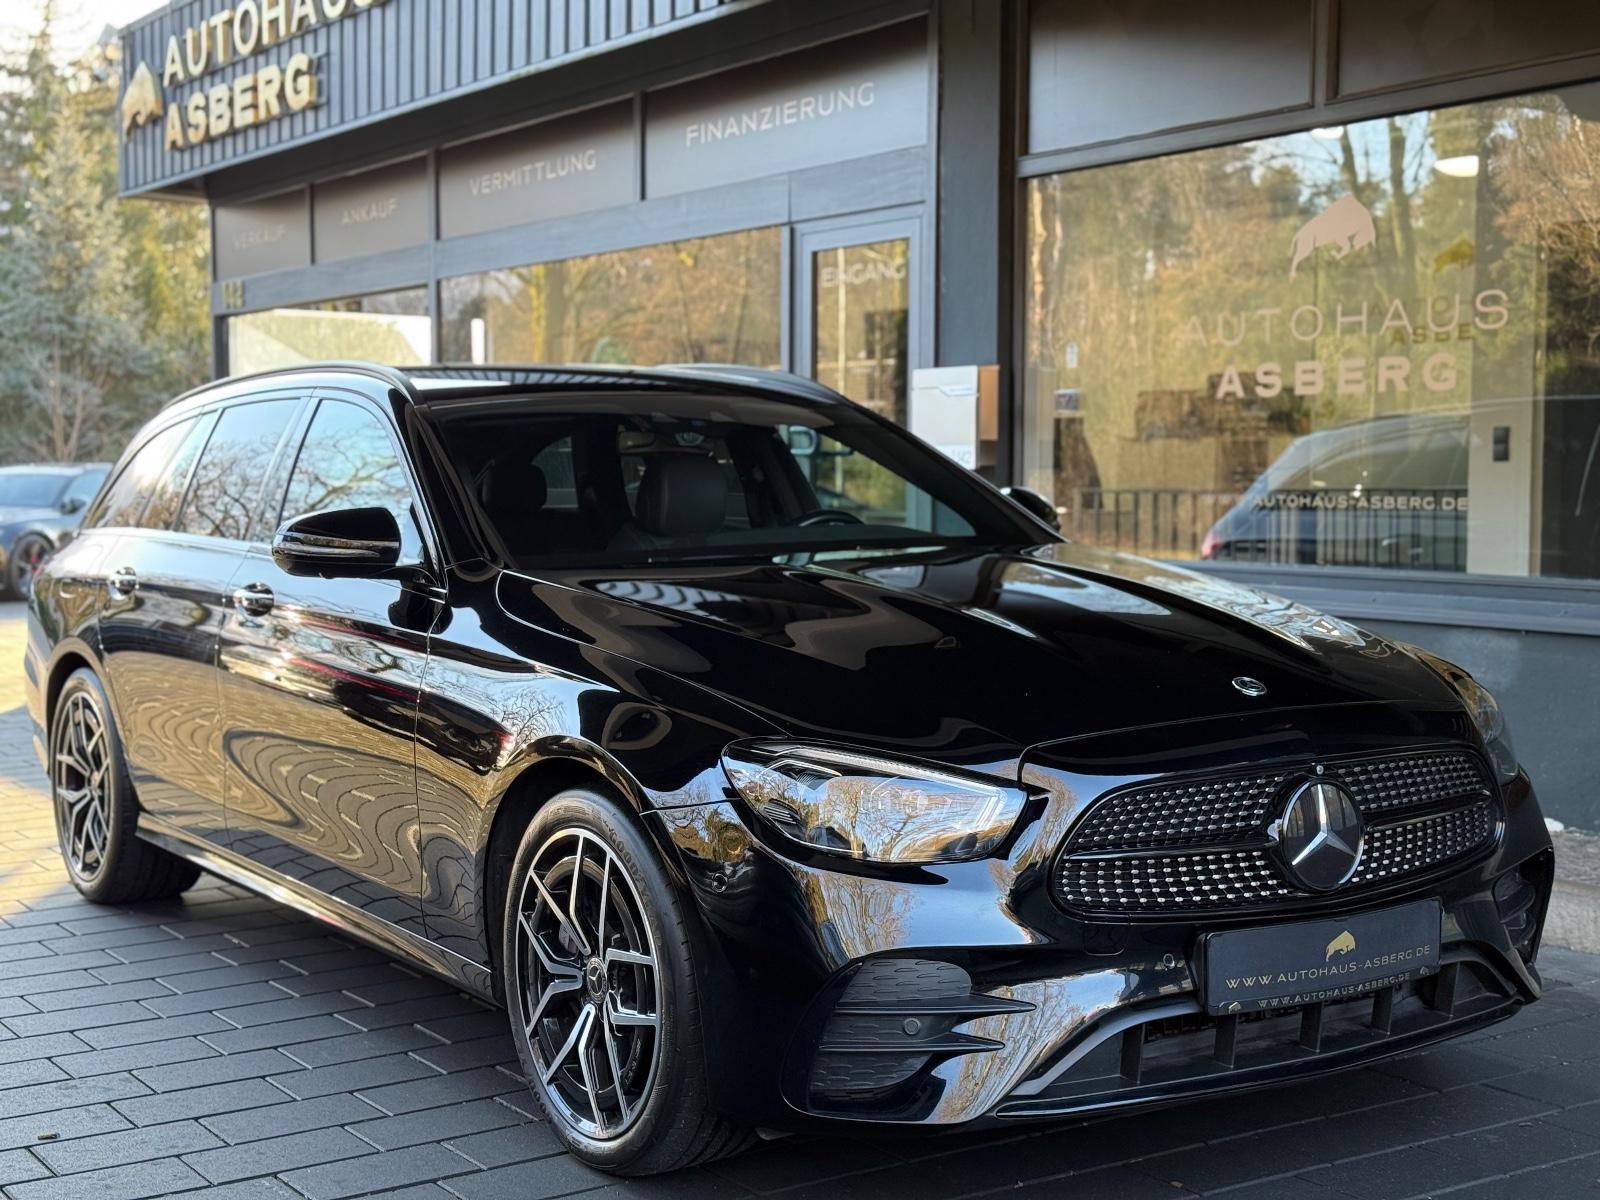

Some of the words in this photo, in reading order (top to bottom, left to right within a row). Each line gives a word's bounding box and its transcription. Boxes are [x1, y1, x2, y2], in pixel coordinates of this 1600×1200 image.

[163, 0, 374, 87] AUTOHA
[164, 52, 312, 151] ASBERG
[685, 82, 875, 147] FINANZIERUNG
[469, 148, 597, 197] VERMITTLUNG
[341, 198, 398, 226] ANKAUF
[1183, 288, 1509, 348] AUTOHAUS
[1216, 352, 1459, 399] ASBERG
[1225, 944, 1431, 990] WWW.AUTOHAUS-ASBERG.DE
[1256, 971, 1411, 1009] WWW.AUTOHAUS-ASBERG.DE
